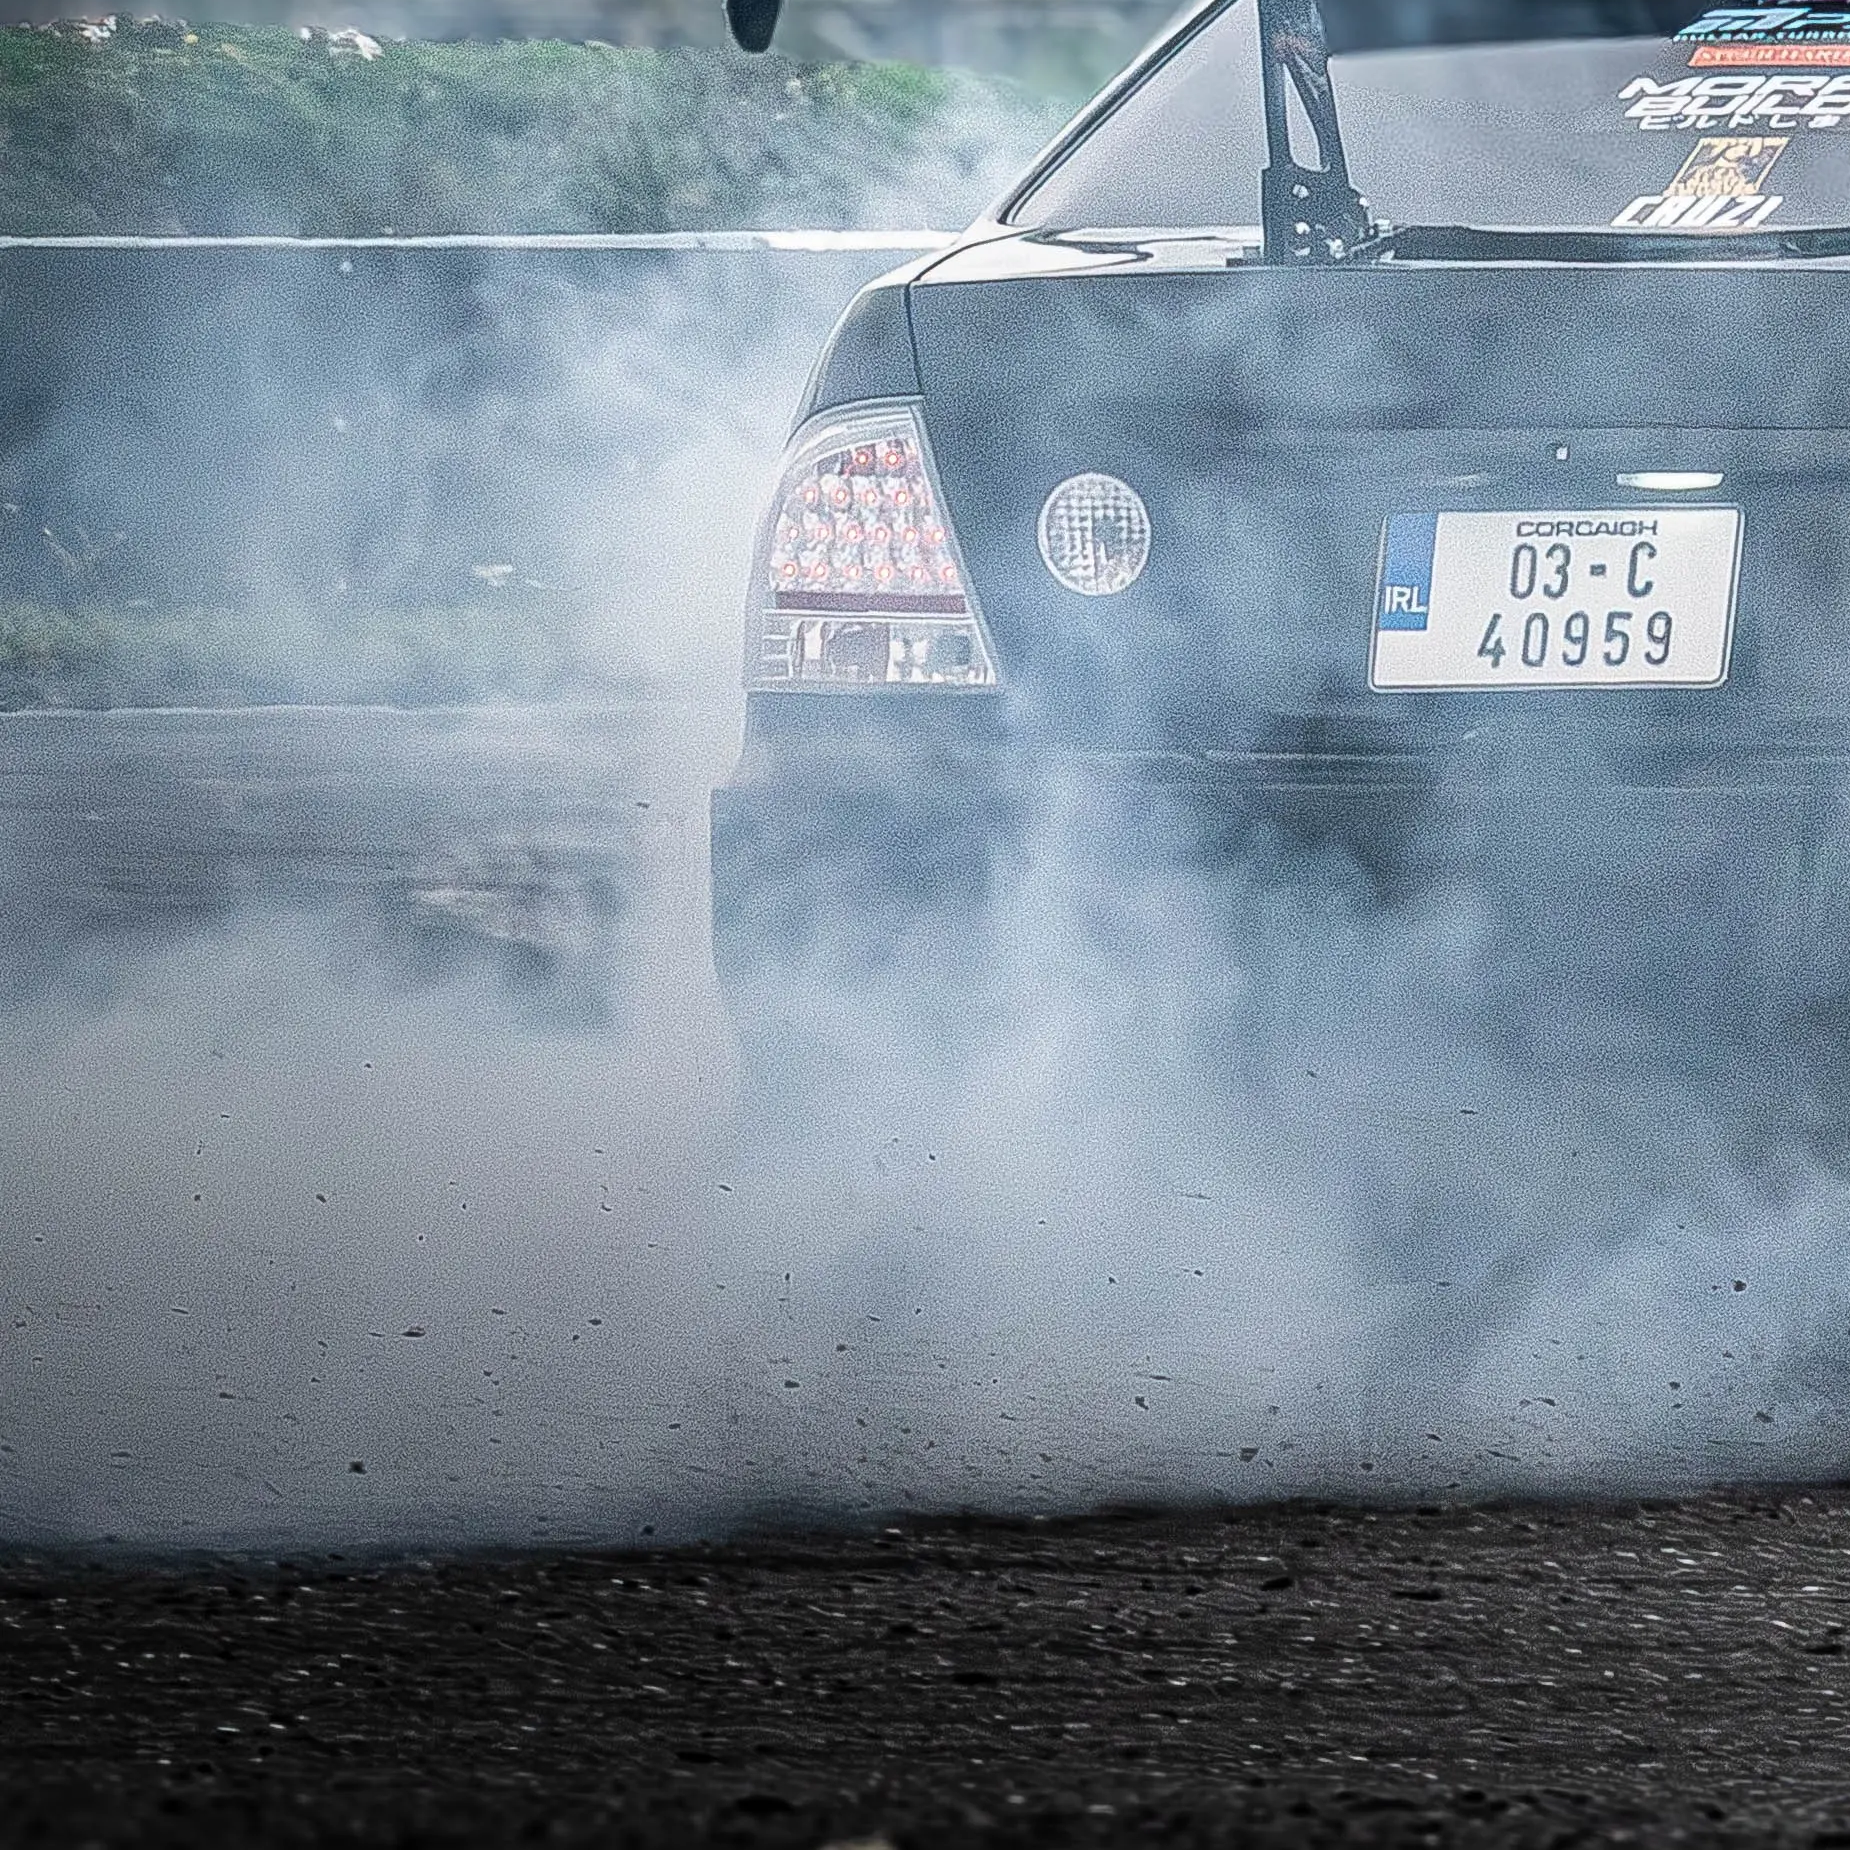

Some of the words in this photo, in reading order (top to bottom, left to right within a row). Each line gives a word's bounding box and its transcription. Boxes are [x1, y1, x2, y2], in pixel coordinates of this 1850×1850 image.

[1516, 520, 1658, 537] CORCAIGH
[1384, 586, 1427, 614] IRL
[1477, 610, 1673, 668] 40959
